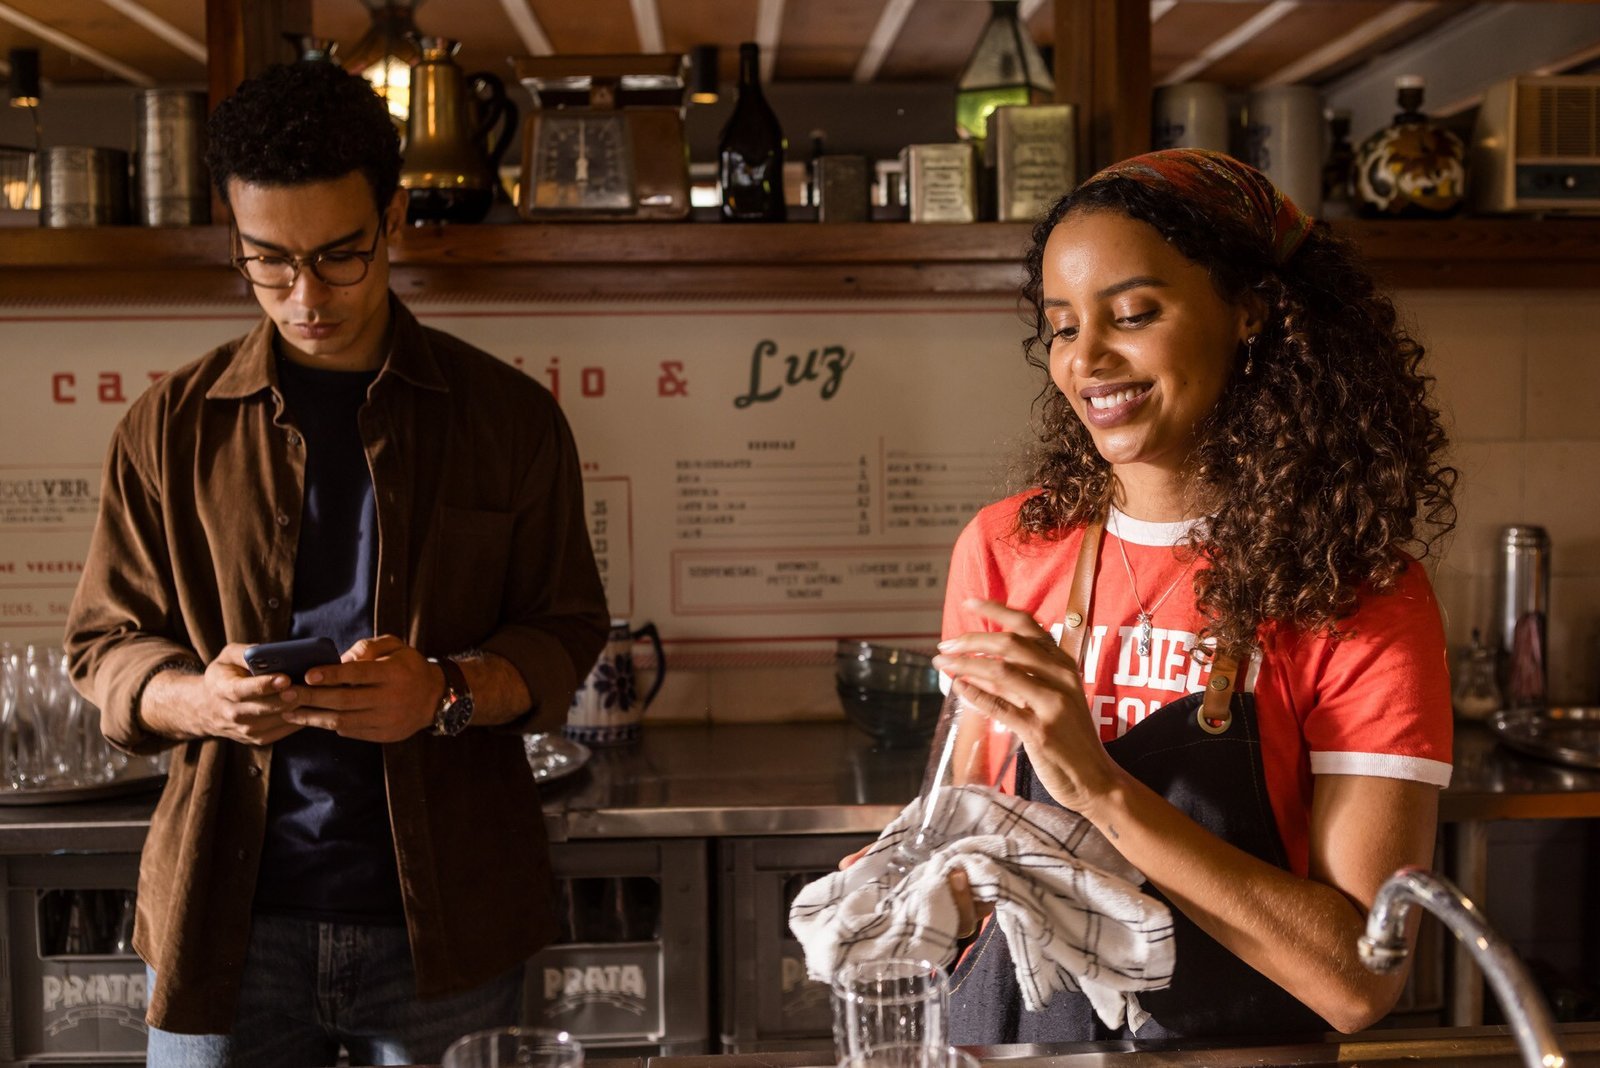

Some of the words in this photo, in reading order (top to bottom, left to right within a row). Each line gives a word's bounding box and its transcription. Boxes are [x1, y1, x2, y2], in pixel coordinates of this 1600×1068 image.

[657, 361, 689, 397] &
[733, 339, 855, 409] Luz
[42, 973, 148, 1013] PRATA
[542, 964, 648, 999] PRATA
